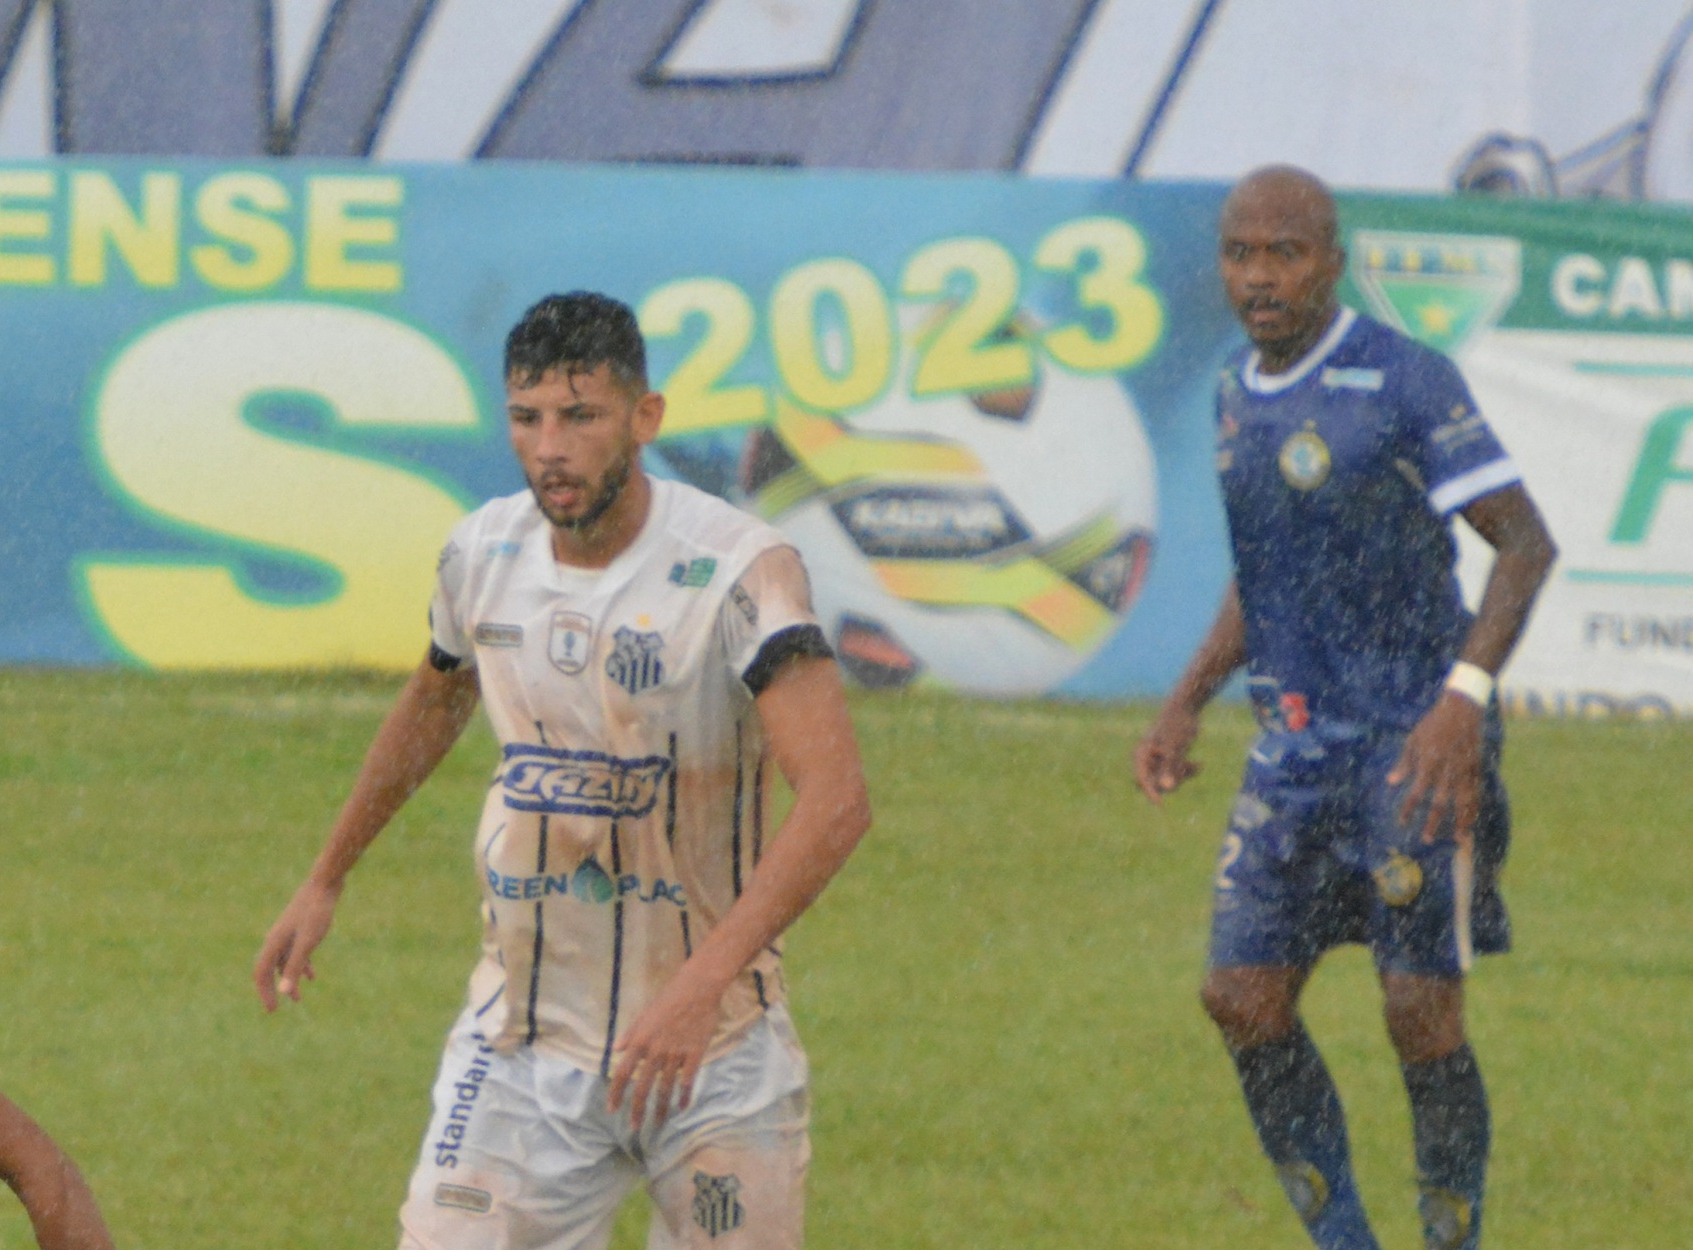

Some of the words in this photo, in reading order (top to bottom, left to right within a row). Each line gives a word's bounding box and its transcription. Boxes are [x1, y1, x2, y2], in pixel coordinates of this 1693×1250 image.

[641, 215, 1164, 442] 2023
[1585, 612, 1693, 652] FUN
[487, 868, 569, 900] REEN
